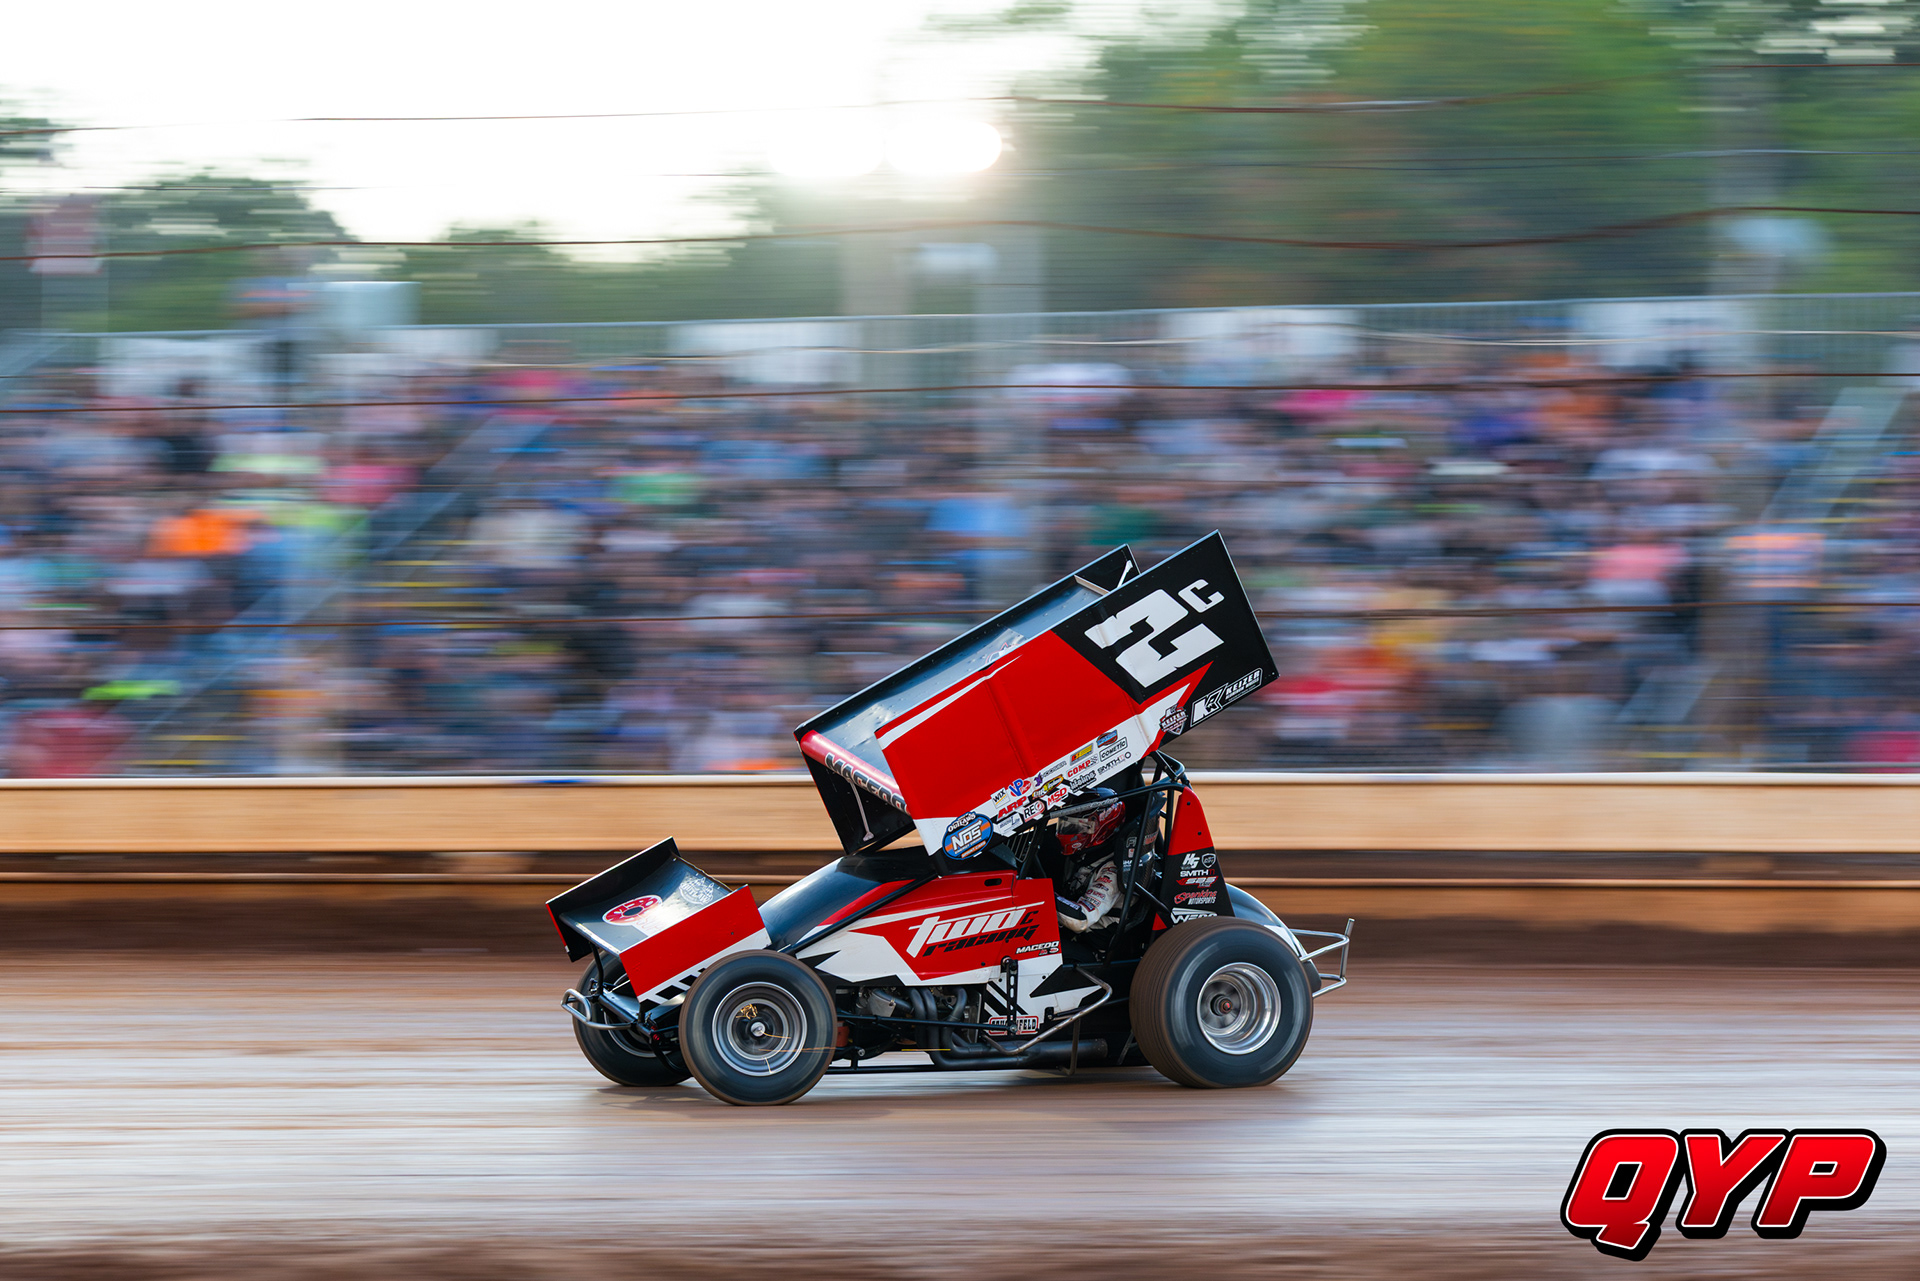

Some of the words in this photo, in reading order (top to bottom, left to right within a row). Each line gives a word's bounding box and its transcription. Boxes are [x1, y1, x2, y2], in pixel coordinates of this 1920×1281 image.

[1226, 671, 1260, 695] KEIZER
[1101, 740, 1126, 759] COMETIC
[1067, 759, 1091, 778] COMP
[993, 789, 1006, 803] WIX
[1009, 778, 1024, 797] VP
[1047, 787, 1067, 806] MSD
[998, 796, 1027, 818] ARP
[951, 820, 983, 851] NOS
[923, 924, 1040, 957] racing
[1015, 941, 1060, 954] MACEDO
